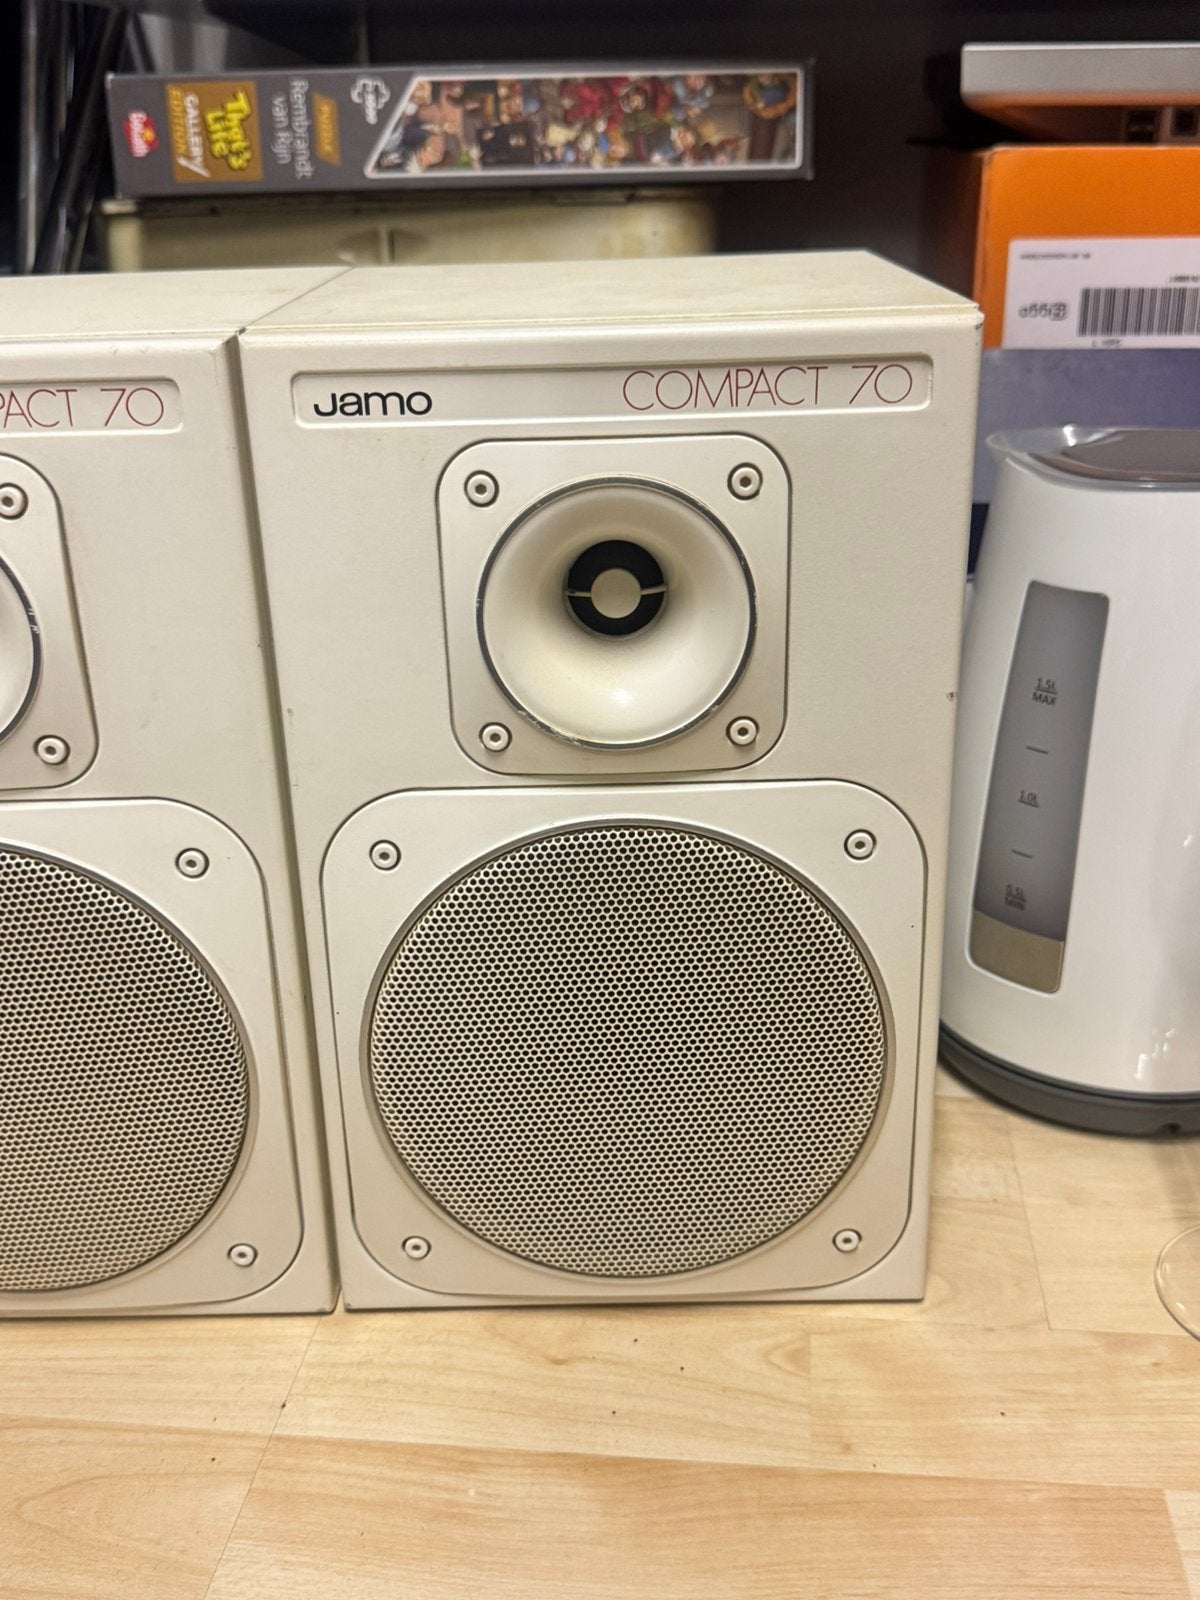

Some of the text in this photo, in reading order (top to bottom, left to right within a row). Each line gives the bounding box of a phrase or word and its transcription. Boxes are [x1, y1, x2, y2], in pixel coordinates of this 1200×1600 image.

[170, 89, 188, 154] EDITION
[204, 111, 229, 158] Life
[271, 95, 288, 129] van
[290, 76, 316, 180] Rembrandt
[178, 94, 211, 178] GALLERY
[100, 387, 165, 427] 70
[313, 390, 432, 415] jamo
[622, 364, 912, 411] COMPACT 70
[1032, 691, 1057, 706] MAX
